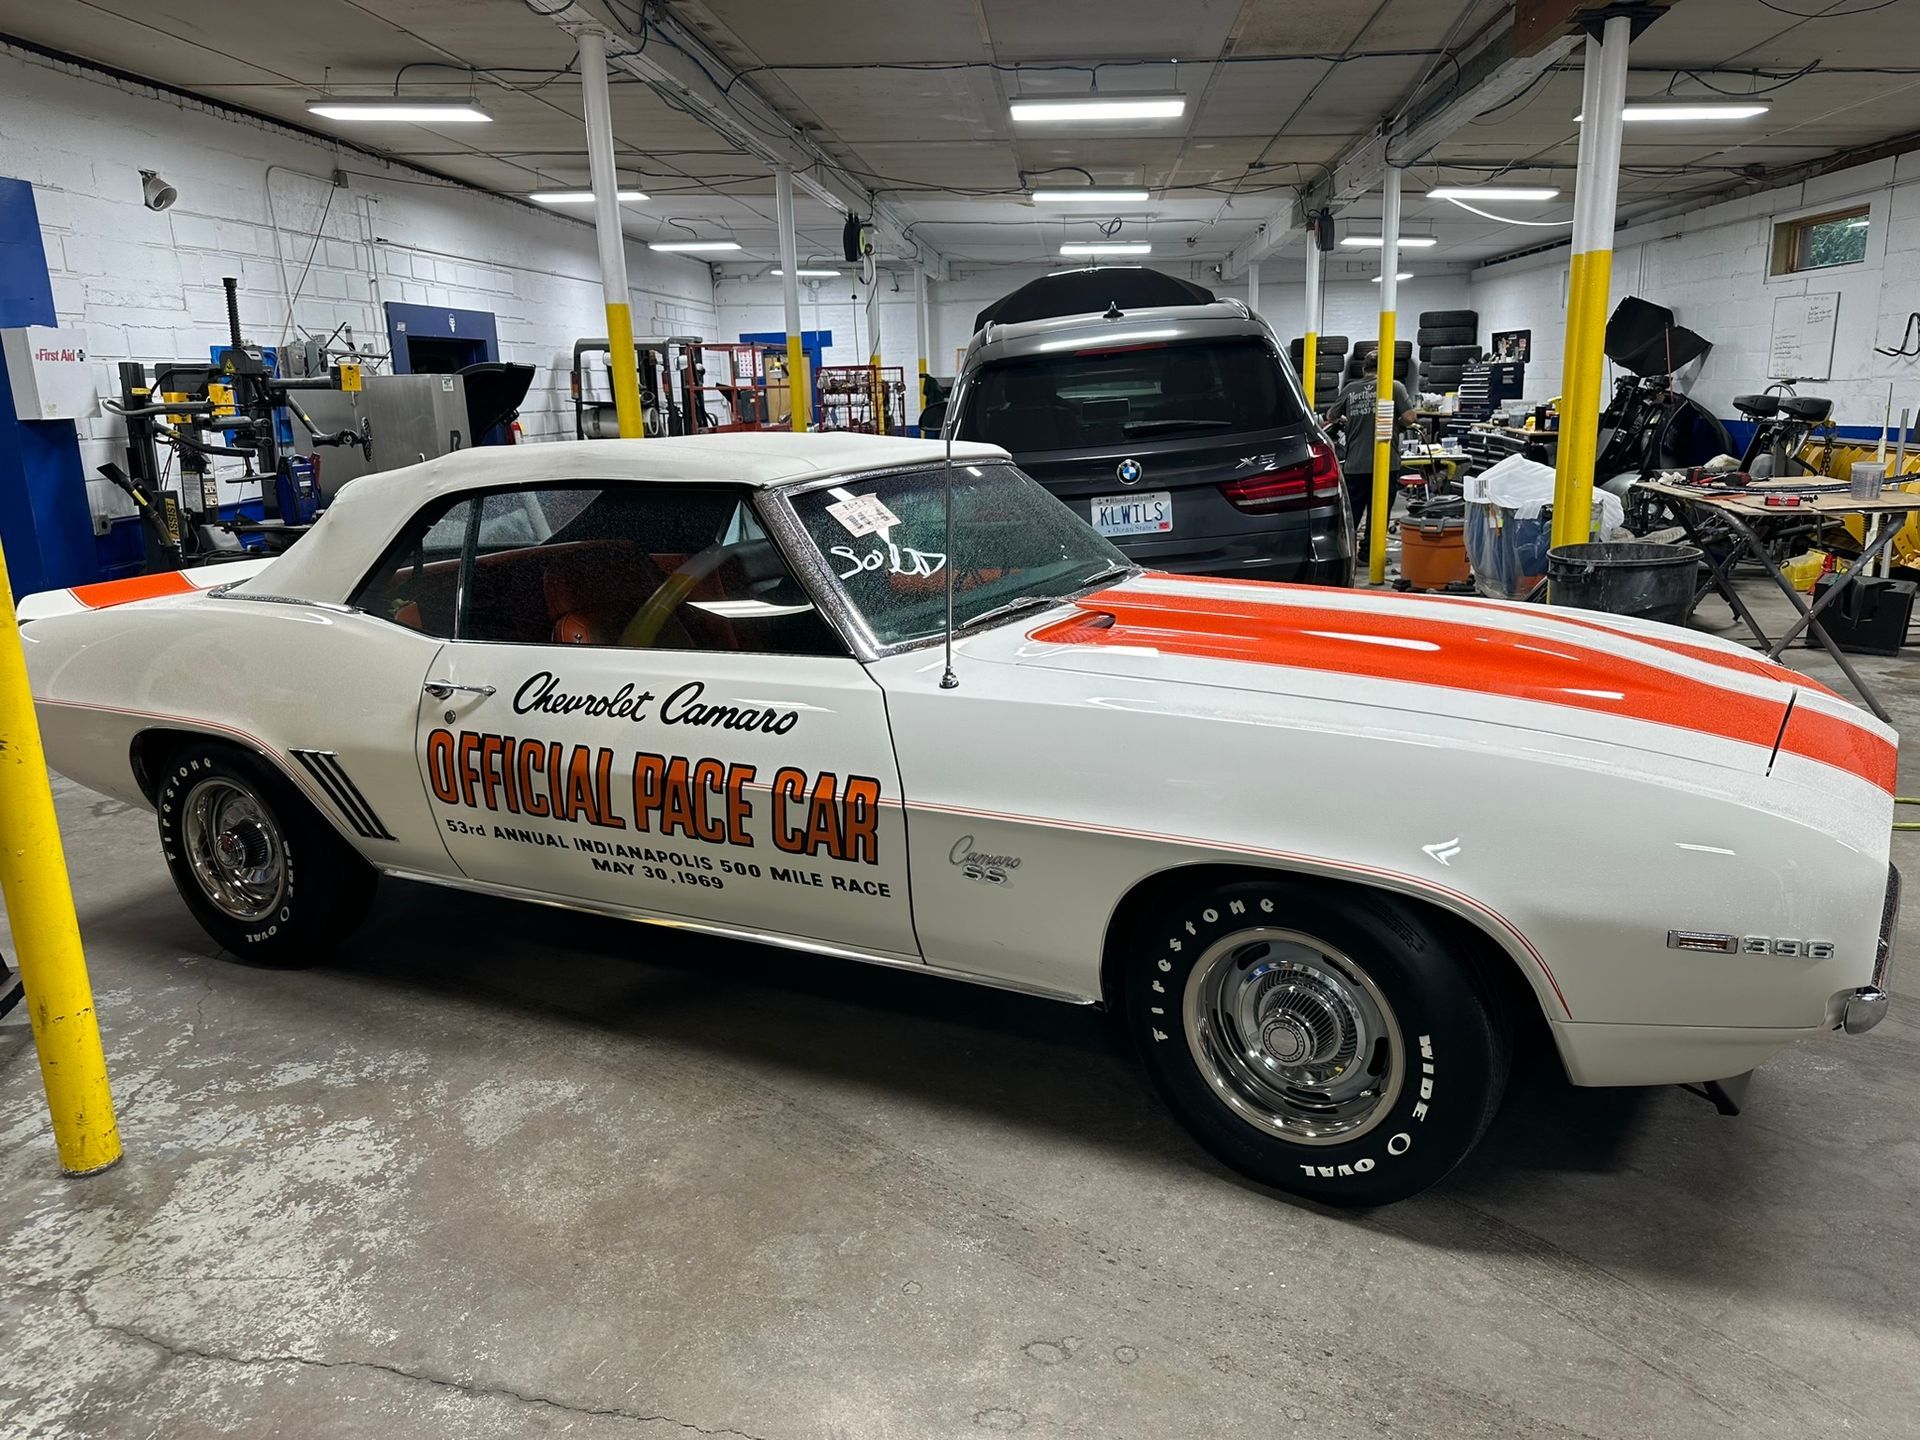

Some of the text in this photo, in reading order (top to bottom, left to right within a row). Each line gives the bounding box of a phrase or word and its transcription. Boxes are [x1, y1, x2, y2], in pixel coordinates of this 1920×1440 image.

[39, 348, 59, 362] First
[60, 349, 76, 362] Aid
[166, 500, 179, 537] ASSIST
[1099, 501, 1164, 527] KLWILS
[1113, 525, 1134, 534] Ocean
[1135, 524, 1153, 532] State
[513, 671, 799, 736] Chevrolet Camaro
[427, 728, 882, 866] OFFICIAL PACE CAR
[446, 819, 892, 898] 53rd ANNUAL INDIANAPOLIS 500 MILE RACE
[948, 834, 1021, 869] Camaro
[591, 858, 635, 876] MAY
[962, 863, 1008, 885] SS
[245, 925, 278, 944] OVAL
[1743, 936, 1835, 960] 396
[1412, 1034, 1435, 1123] WIDE
[1299, 1157, 1377, 1178] OVAL
